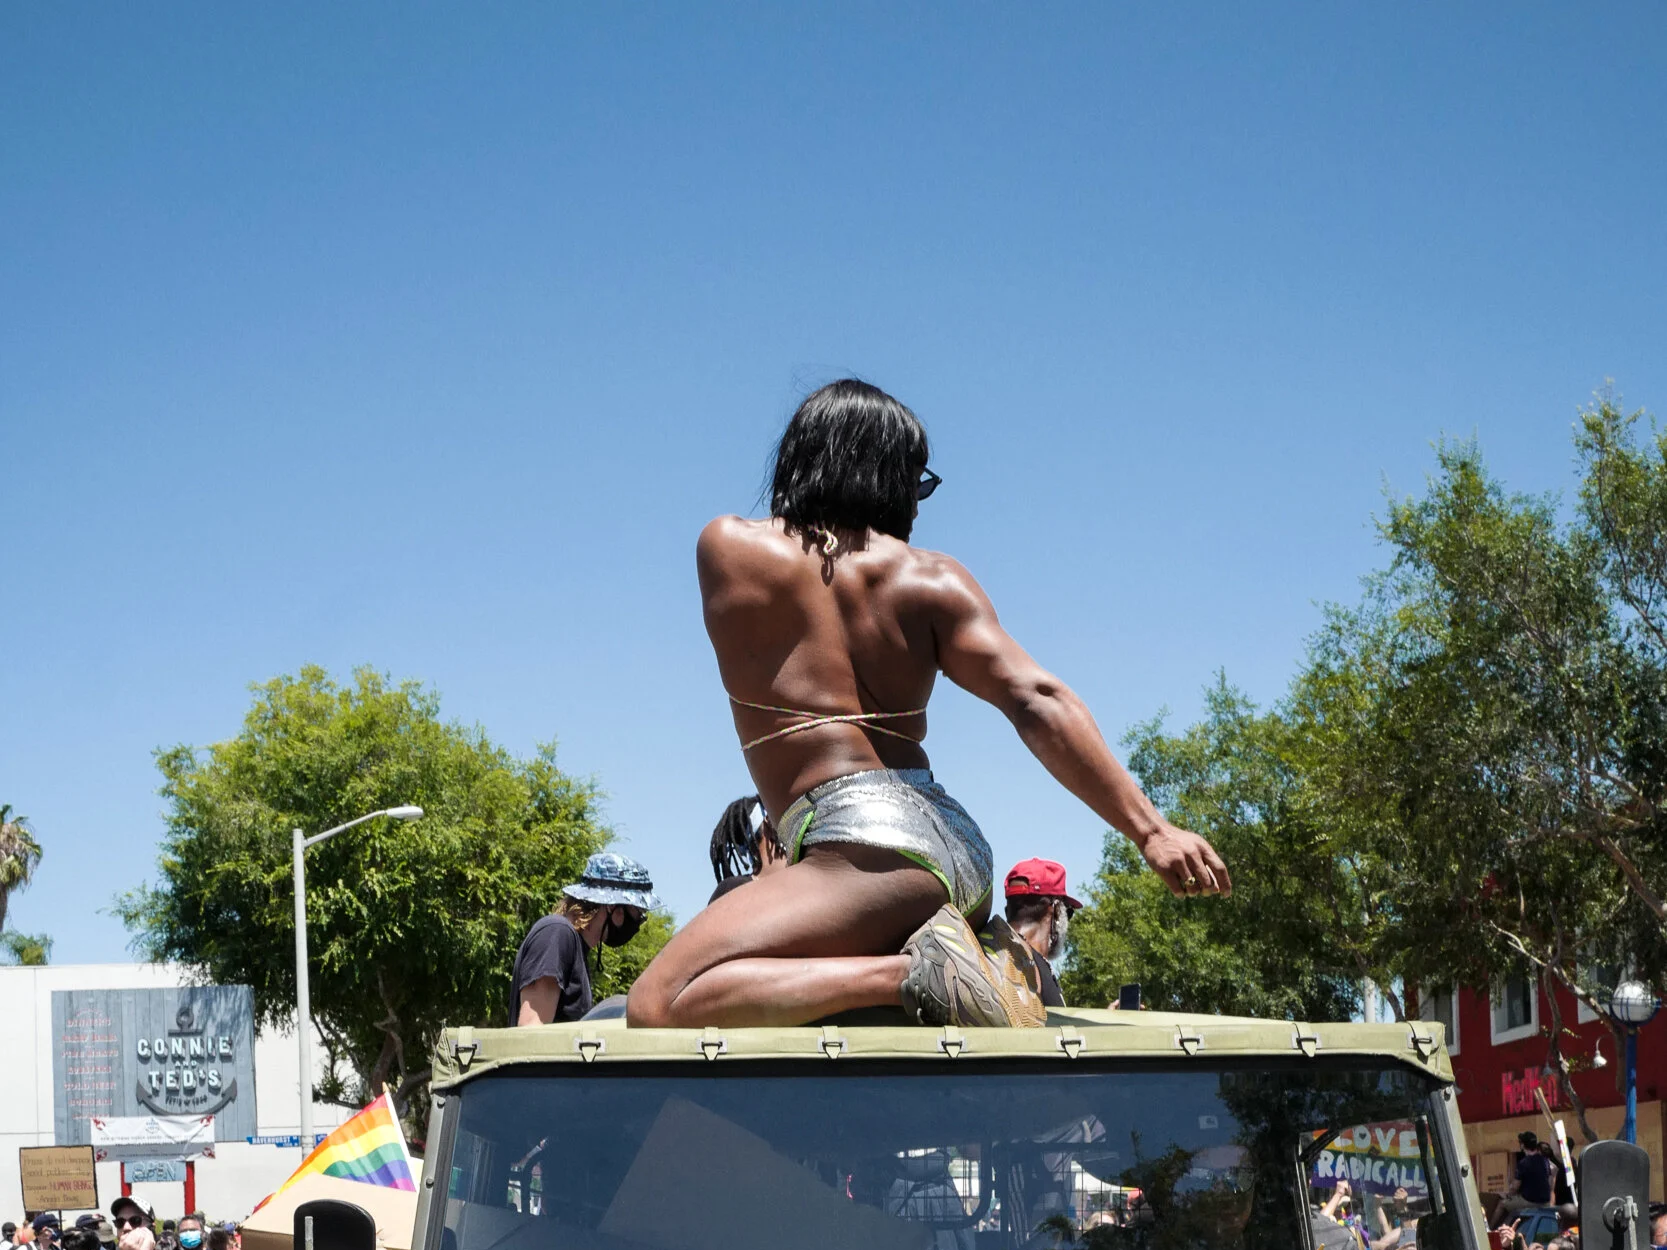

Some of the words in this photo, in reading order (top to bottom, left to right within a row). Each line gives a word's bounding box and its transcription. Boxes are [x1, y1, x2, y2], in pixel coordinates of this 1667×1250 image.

[136, 1035, 233, 1062] CONNIE
[174, 1060, 199, 1069] AND
[147, 1069, 222, 1096] TED'S
[131, 1161, 177, 1182] OPEN
